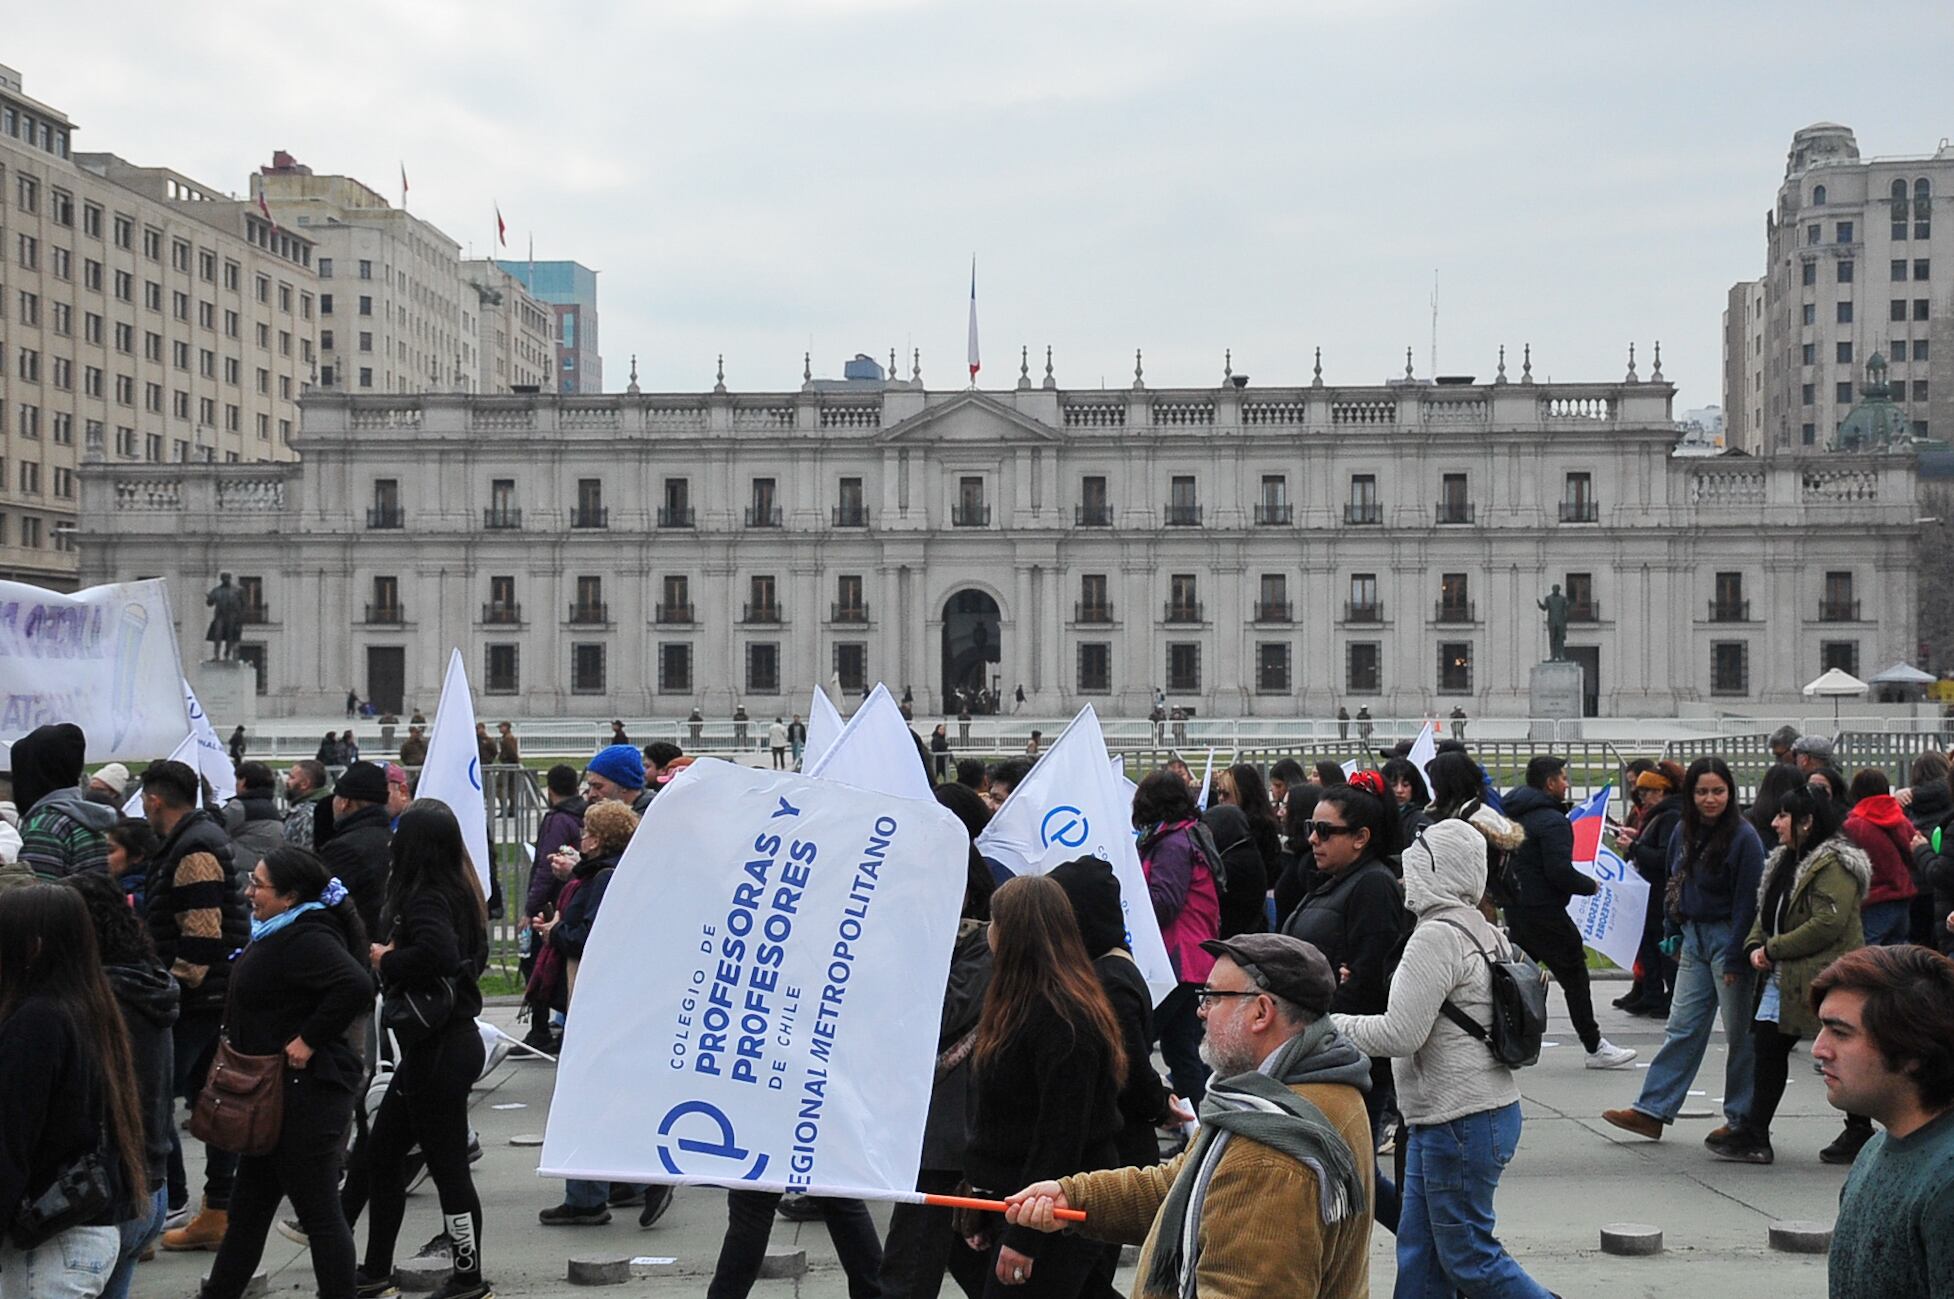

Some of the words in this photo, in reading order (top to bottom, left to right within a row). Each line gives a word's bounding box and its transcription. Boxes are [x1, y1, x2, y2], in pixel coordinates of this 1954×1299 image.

[670, 969, 706, 1070] COLEGIO
[700, 924, 716, 954] DE
[694, 832, 782, 1077] PROFESORAS
[771, 796, 801, 818] Y
[731, 839, 817, 1084] PROFESORES
[813, 816, 897, 1063] METROPOLITANO
[768, 1059, 788, 1090] DE
[778, 985, 802, 1047] CHILE
[451, 1216, 474, 1271] Calvin
